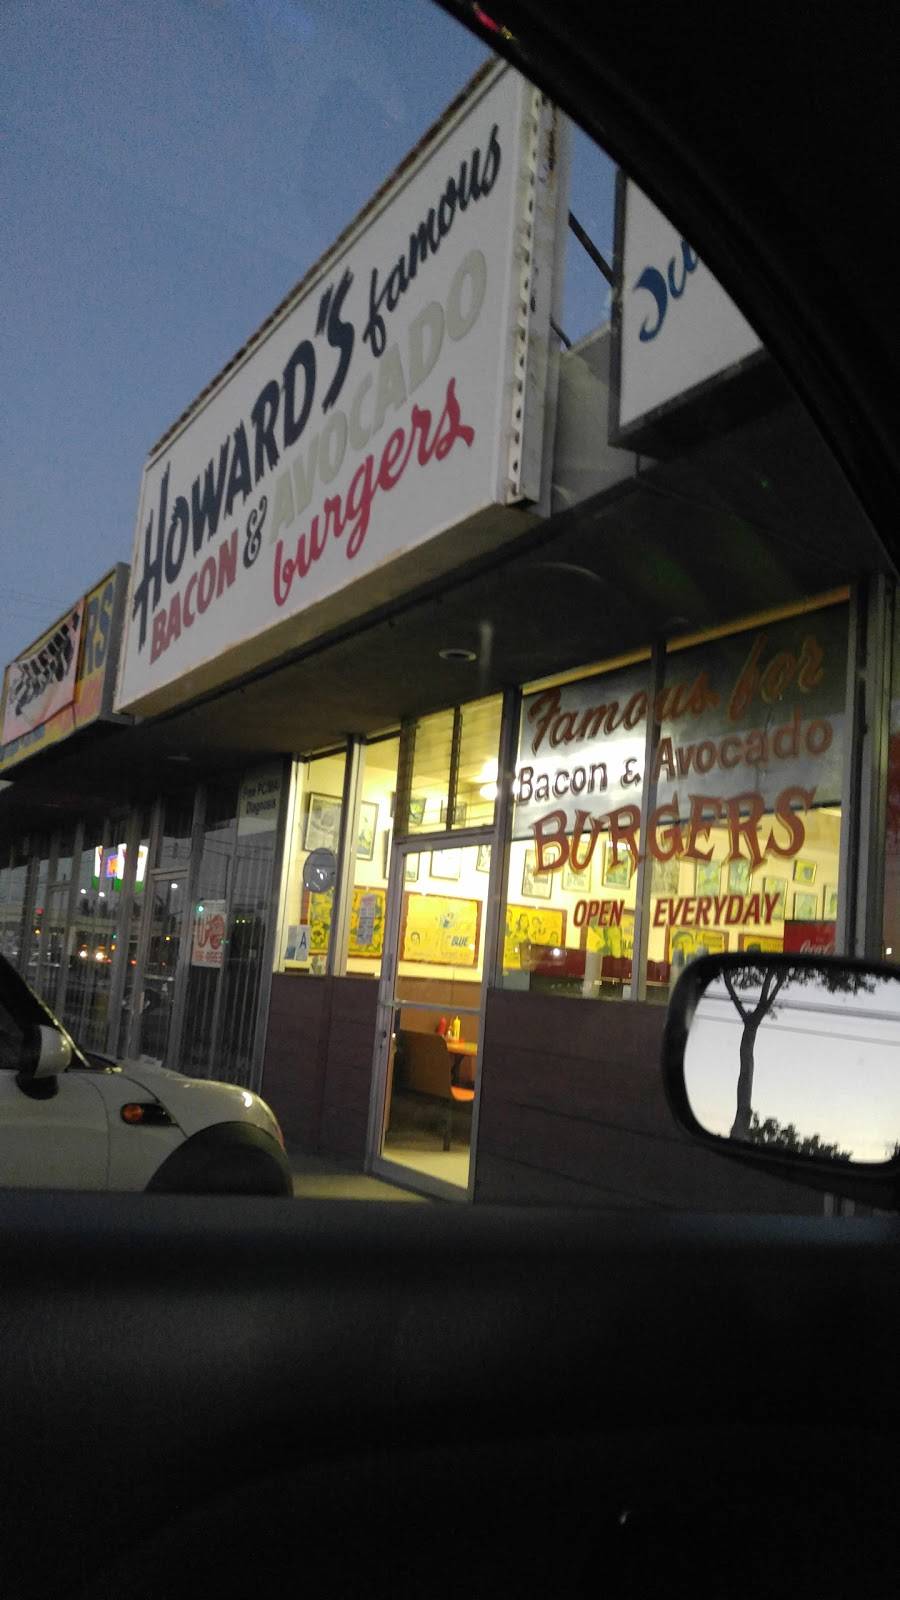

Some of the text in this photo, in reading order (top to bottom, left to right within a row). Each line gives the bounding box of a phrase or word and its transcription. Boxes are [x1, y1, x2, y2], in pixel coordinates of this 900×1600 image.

[362, 123, 502, 357] famous
[150, 249, 488, 664] BACON & AVOCADO
[273, 377, 474, 606] burgers
[516, 710, 834, 804] Bacon & Avocado
[527, 672, 721, 756] Famous
[532, 785, 818, 877] BURGERS
[573, 892, 781, 928] OPEN EVERYDAY
